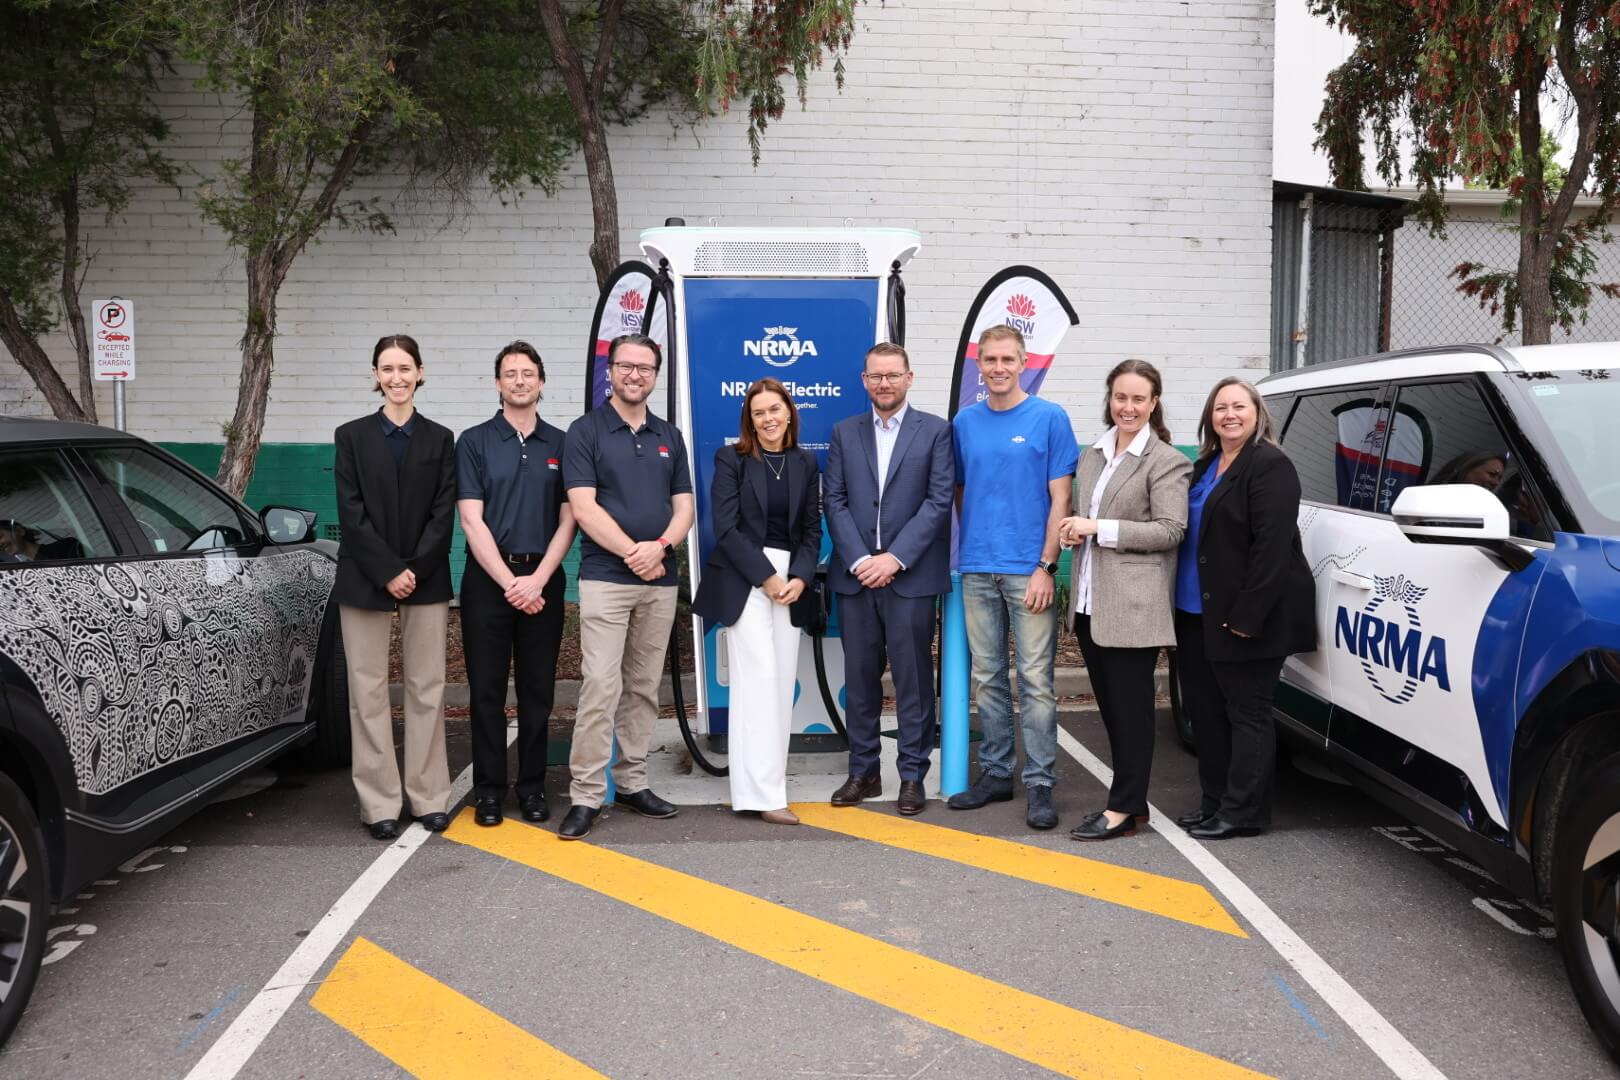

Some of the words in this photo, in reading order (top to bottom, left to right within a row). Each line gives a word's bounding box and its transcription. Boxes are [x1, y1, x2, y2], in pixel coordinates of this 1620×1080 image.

[1006, 317, 1035, 335] NSW
[104, 351, 124, 359] WHILE
[743, 340, 818, 356] NRMA
[97, 359, 132, 367] CHARGING
[721, 381, 752, 397] NR
[782, 381, 841, 397] Electric
[794, 402, 818, 410] gether.
[1335, 605, 1451, 692] NRMA
